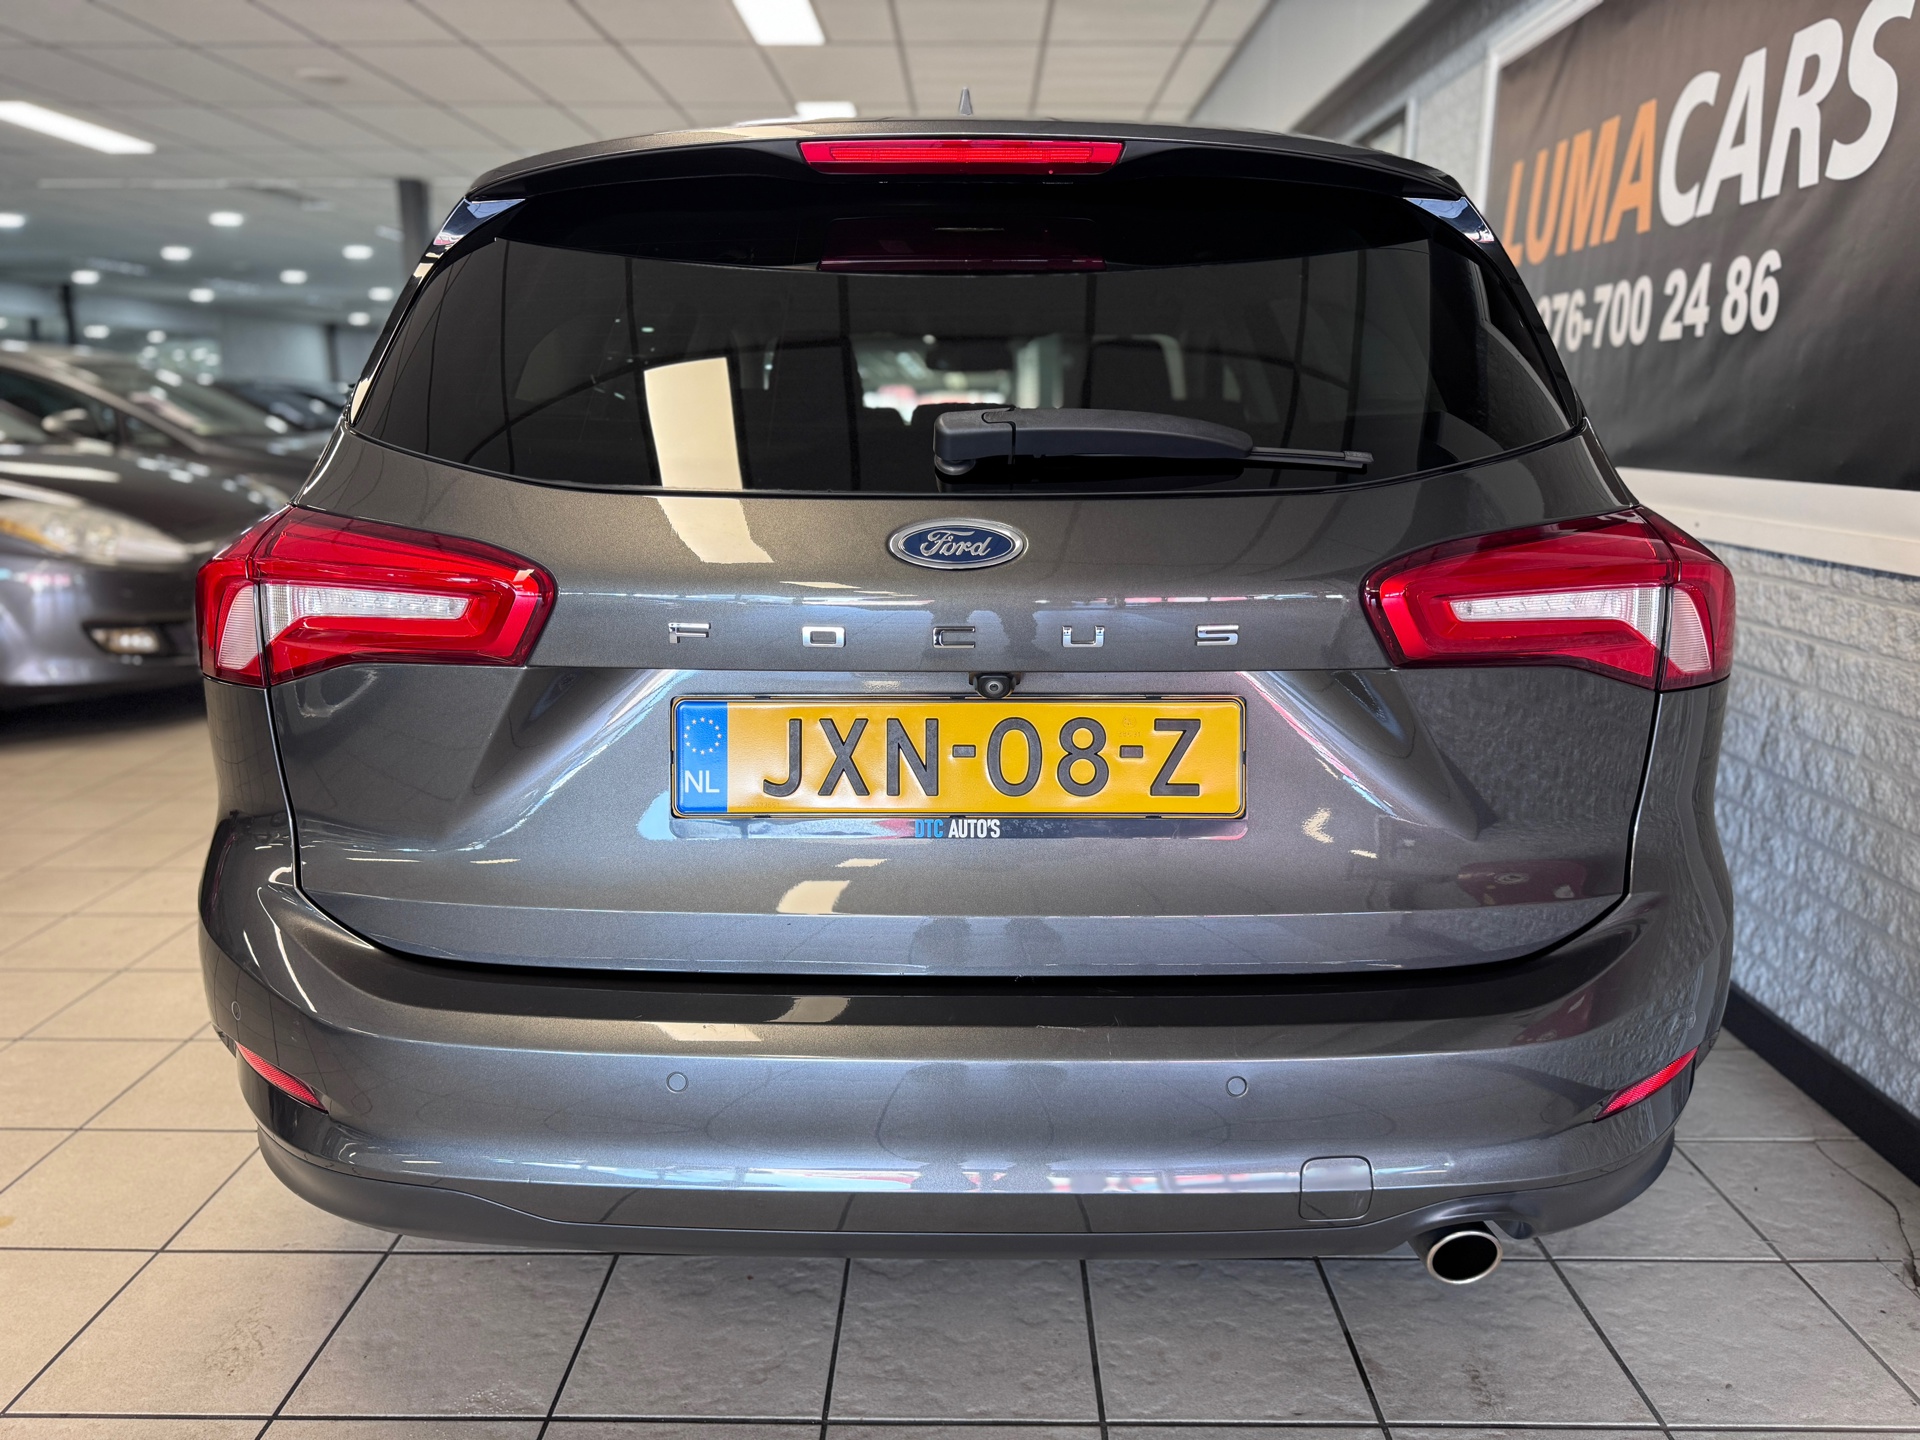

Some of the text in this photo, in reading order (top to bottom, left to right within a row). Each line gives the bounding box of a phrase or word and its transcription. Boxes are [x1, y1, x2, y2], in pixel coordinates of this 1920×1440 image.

[1658, 262, 1711, 341] 24
[1721, 249, 1782, 335] 86
[919, 529, 994, 557] Ford
[668, 621, 1239, 650] FOCUS
[762, 717, 1201, 797] JXN-08-Z
[684, 769, 720, 793] NL
[914, 818, 1000, 839] DTC AUTO'S
